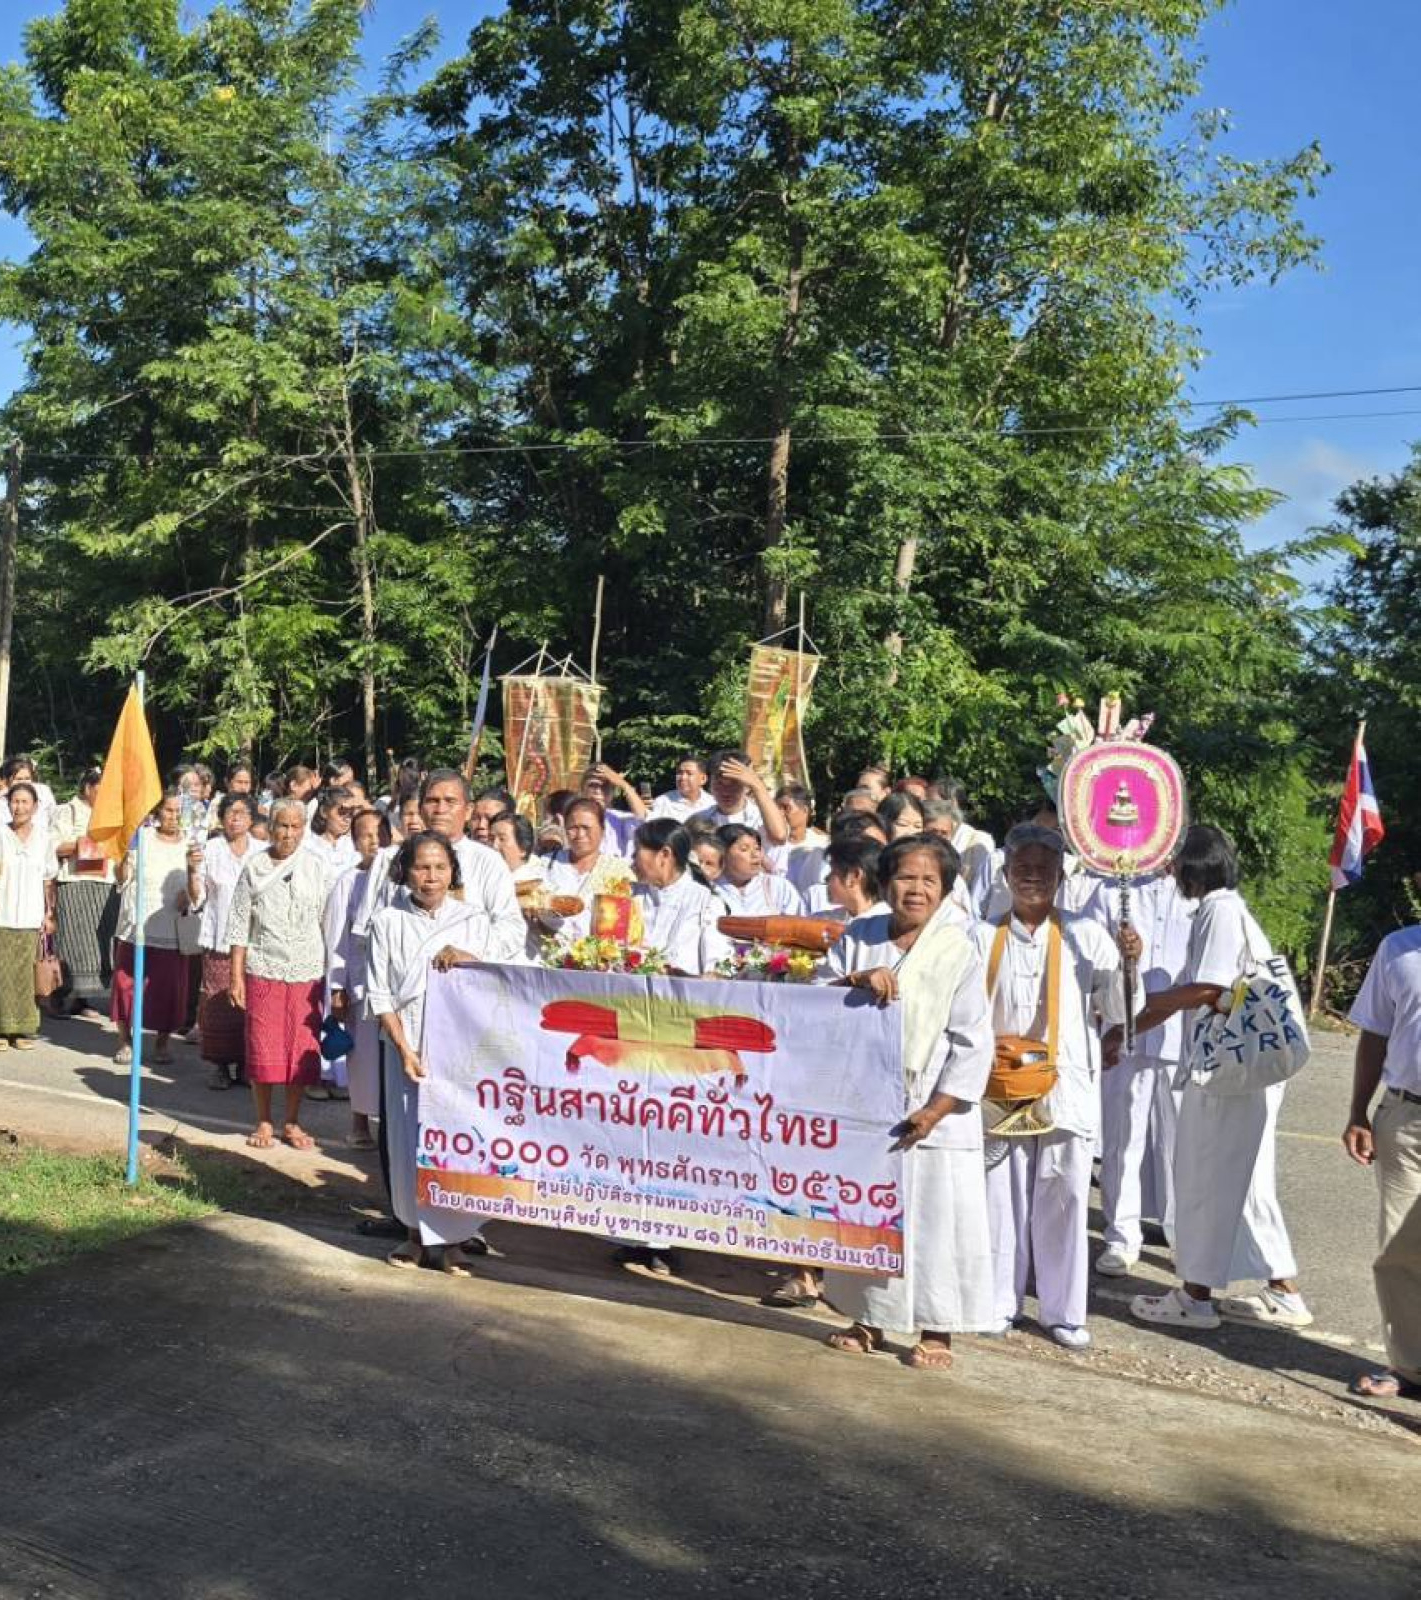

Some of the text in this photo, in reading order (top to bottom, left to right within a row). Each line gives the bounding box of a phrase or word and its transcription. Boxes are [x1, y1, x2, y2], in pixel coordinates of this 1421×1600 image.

[477, 1067, 838, 1149] กฐินสามัคคีทั่วไทย
[424, 1127, 898, 1209] ๓๐,๐๐๐ วัด พุทธศักราช ๒๕๖๘
[536, 1175, 767, 1228] ศูนย์ปฏิบัติธรรมหนองบัวลำภู
[430, 1185, 900, 1270] โดย คณะศิษยานุศิษย์ บูชาธรรม ๘๑ ปี หลวงพ่อธัมมชโย
